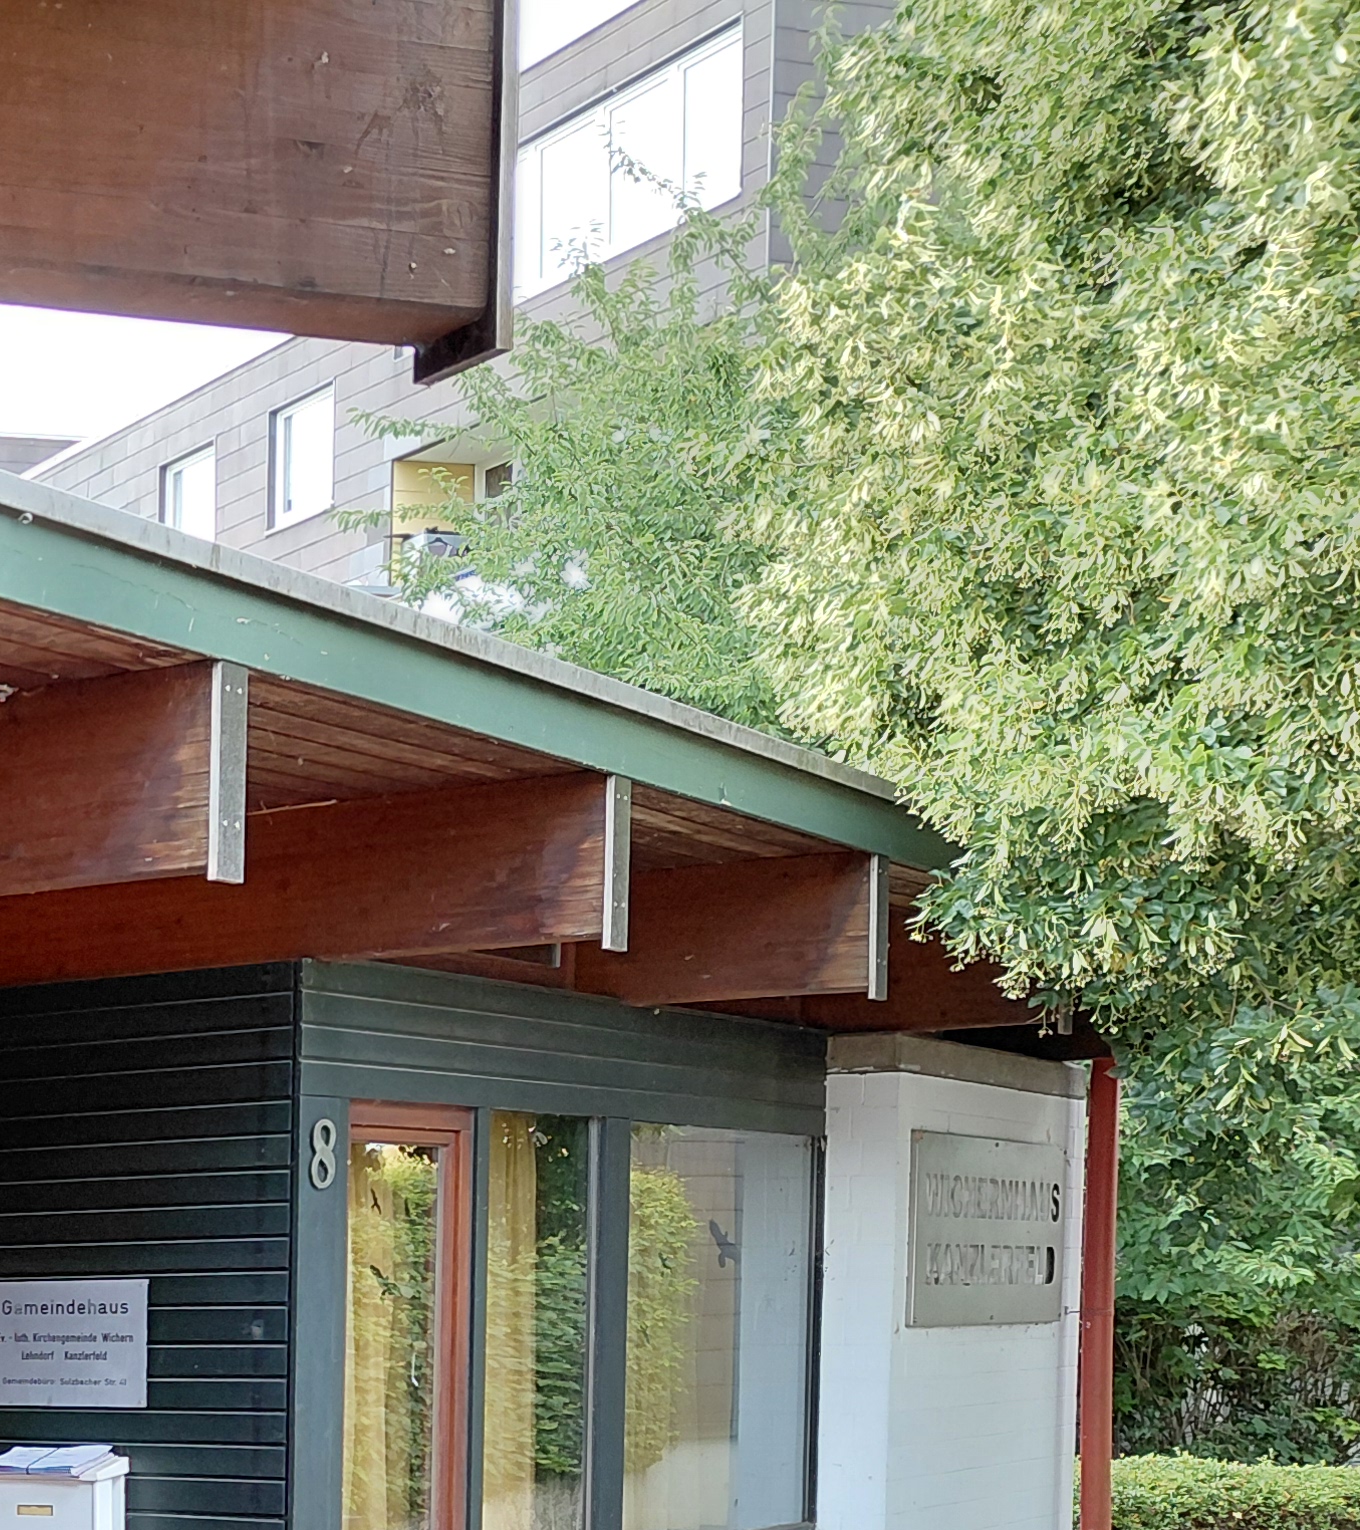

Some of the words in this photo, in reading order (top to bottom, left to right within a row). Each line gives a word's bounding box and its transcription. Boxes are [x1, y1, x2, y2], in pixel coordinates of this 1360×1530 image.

[311, 1118, 337, 1190] 8
[925, 1172, 1061, 1223] WICHERNHAUS
[925, 1242, 1056, 1287] KANZLERFELD
[1, 1299, 129, 1316] Gemeindehaus
[32, 1332, 97, 1345] Kirchengemeinde
[101, 1332, 134, 1343] Wichern
[21, 1351, 55, 1361] Lehndorf
[64, 1351, 108, 1361] Kanzlerfeld
